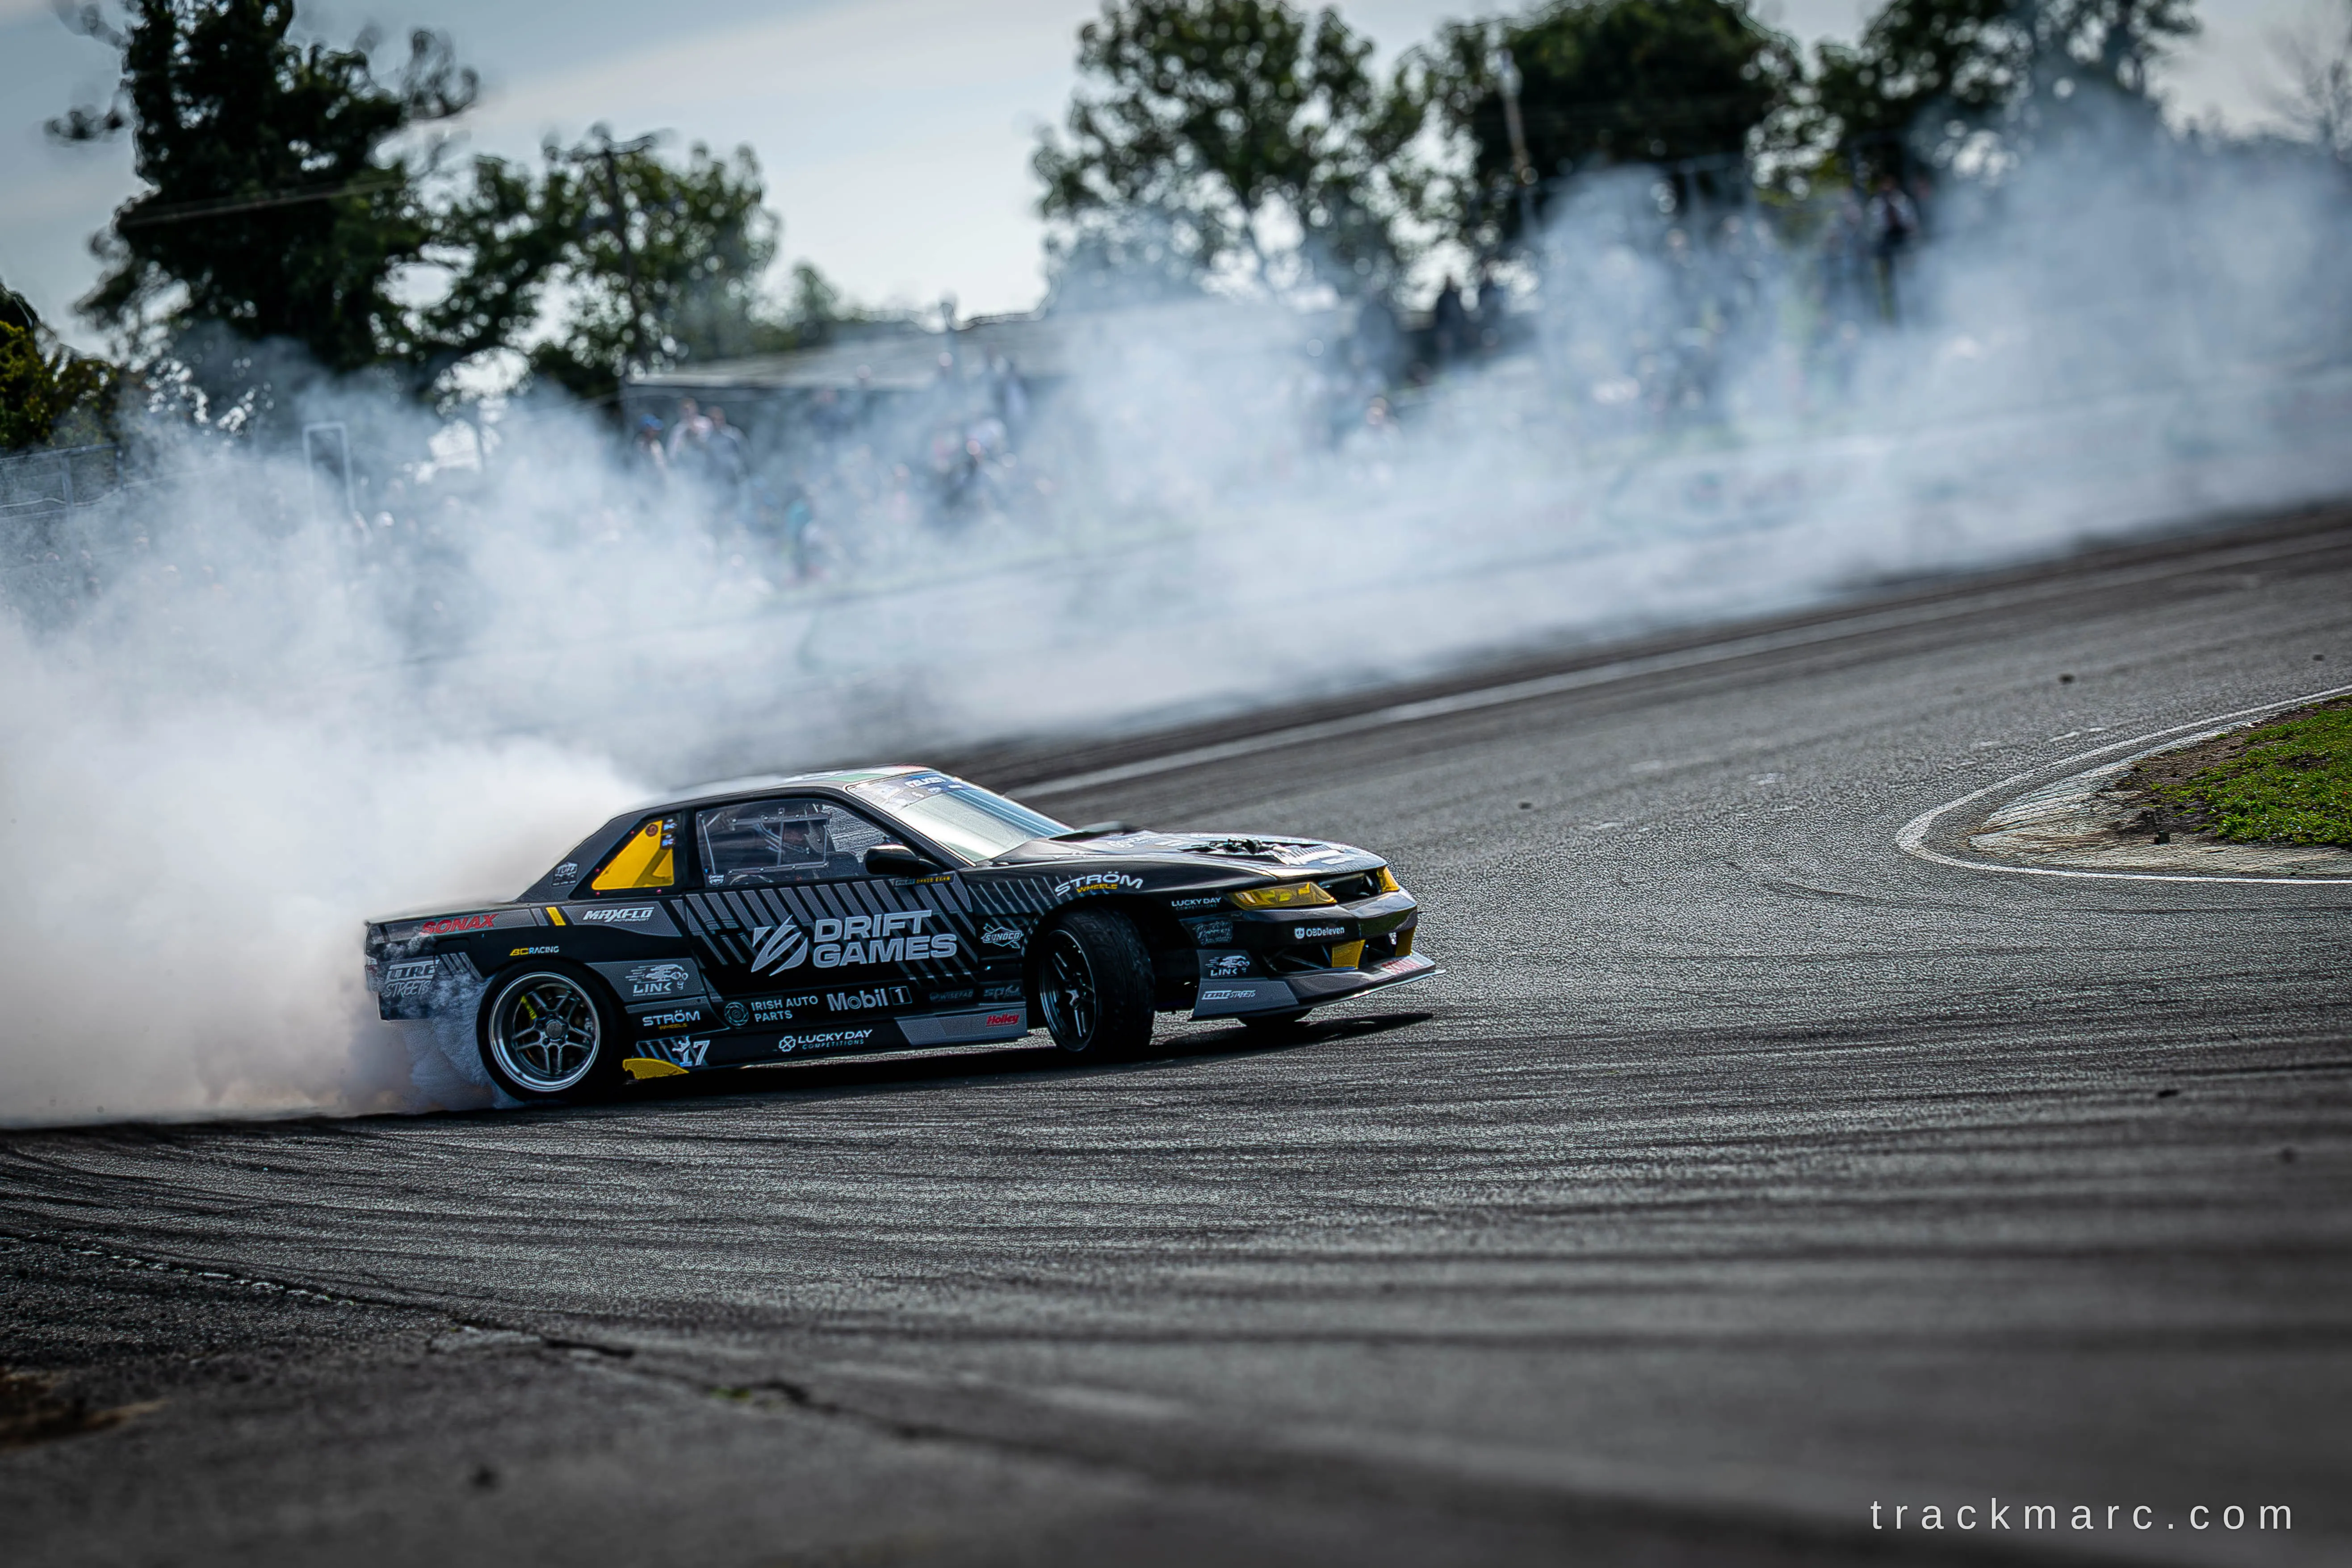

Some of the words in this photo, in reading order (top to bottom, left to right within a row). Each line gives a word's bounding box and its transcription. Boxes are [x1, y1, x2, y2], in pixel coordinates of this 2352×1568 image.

[1055, 871, 1144, 896] STRÖM
[1076, 884, 1118, 893] WHEELS
[420, 914, 499, 935] SONAX
[814, 910, 932, 943] DRIFT
[1306, 926, 1345, 937] OBDeleven
[985, 932, 1020, 941] SUNOCO
[813, 934, 957, 968] GAMES
[633, 982, 672, 994] LINK
[751, 999, 782, 1011] IRISH
[786, 995, 818, 1007] AUTO
[826, 988, 889, 1011] Mobil
[895, 988, 905, 1003] 1
[642, 1009, 700, 1027] STRÖM
[754, 1010, 793, 1023] PARTS
[986, 1014, 1019, 1027] Holley
[798, 1031, 844, 1044] LUCKY
[844, 1029, 873, 1040] DAY
[802, 1039, 864, 1050] COMPETITIONS
